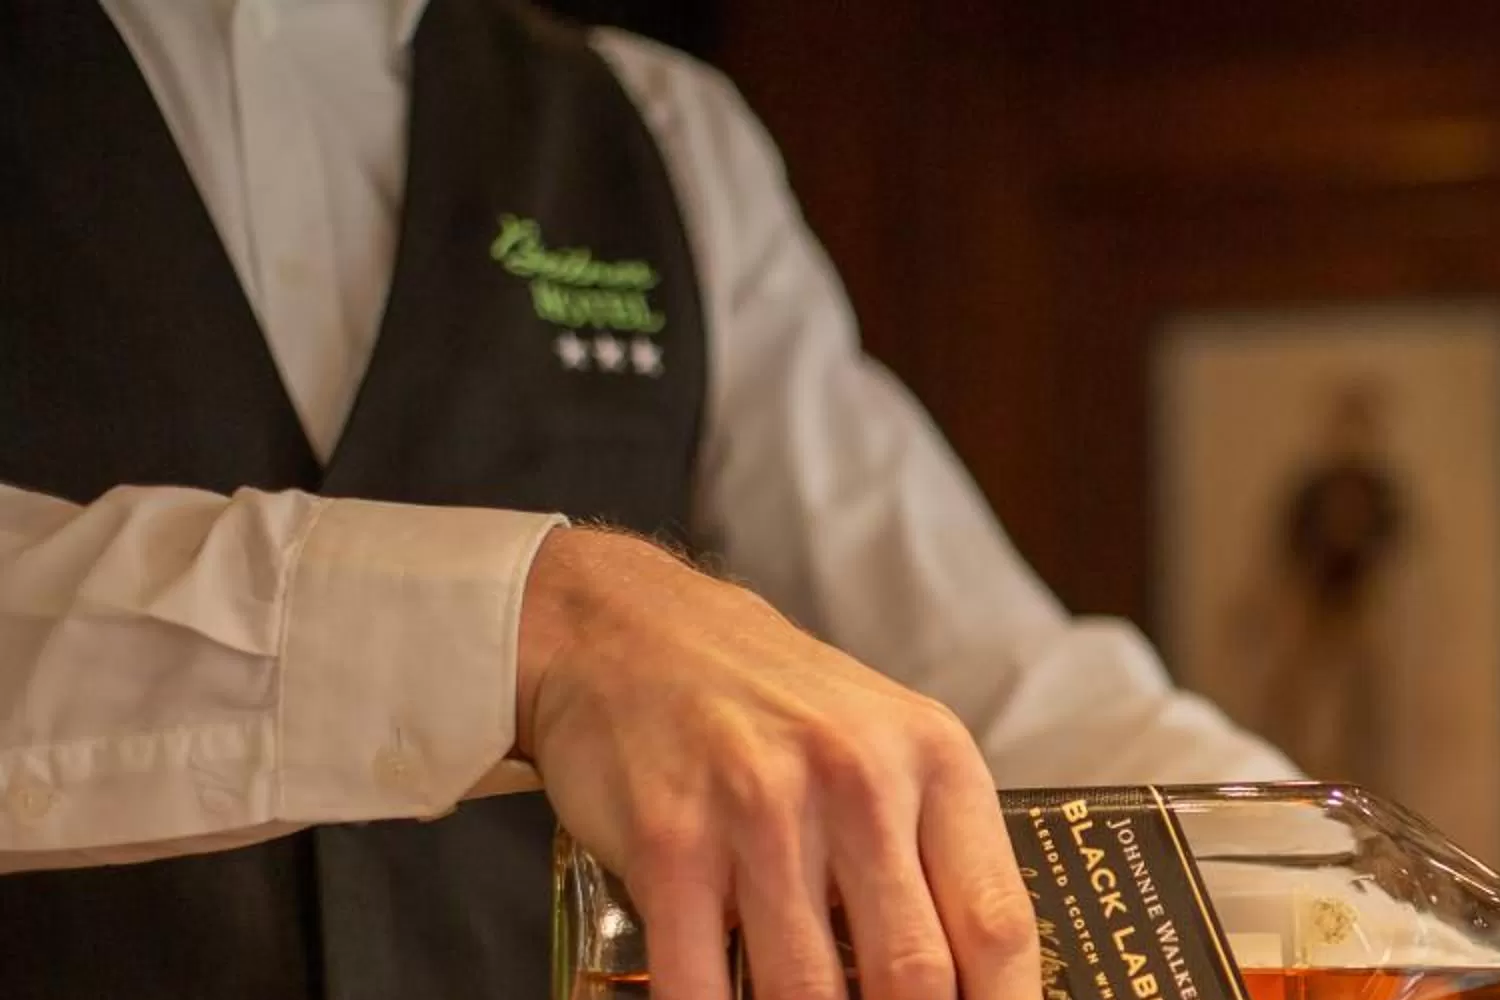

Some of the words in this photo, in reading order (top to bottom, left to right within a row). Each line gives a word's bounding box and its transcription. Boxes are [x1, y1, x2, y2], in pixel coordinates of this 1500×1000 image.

[1029, 807, 1068, 888] BLENDED
[1064, 895, 1100, 966] SCOTCH
[1062, 799, 1126, 919] BLACK
[1107, 818, 1165, 918] JOHNNIE
